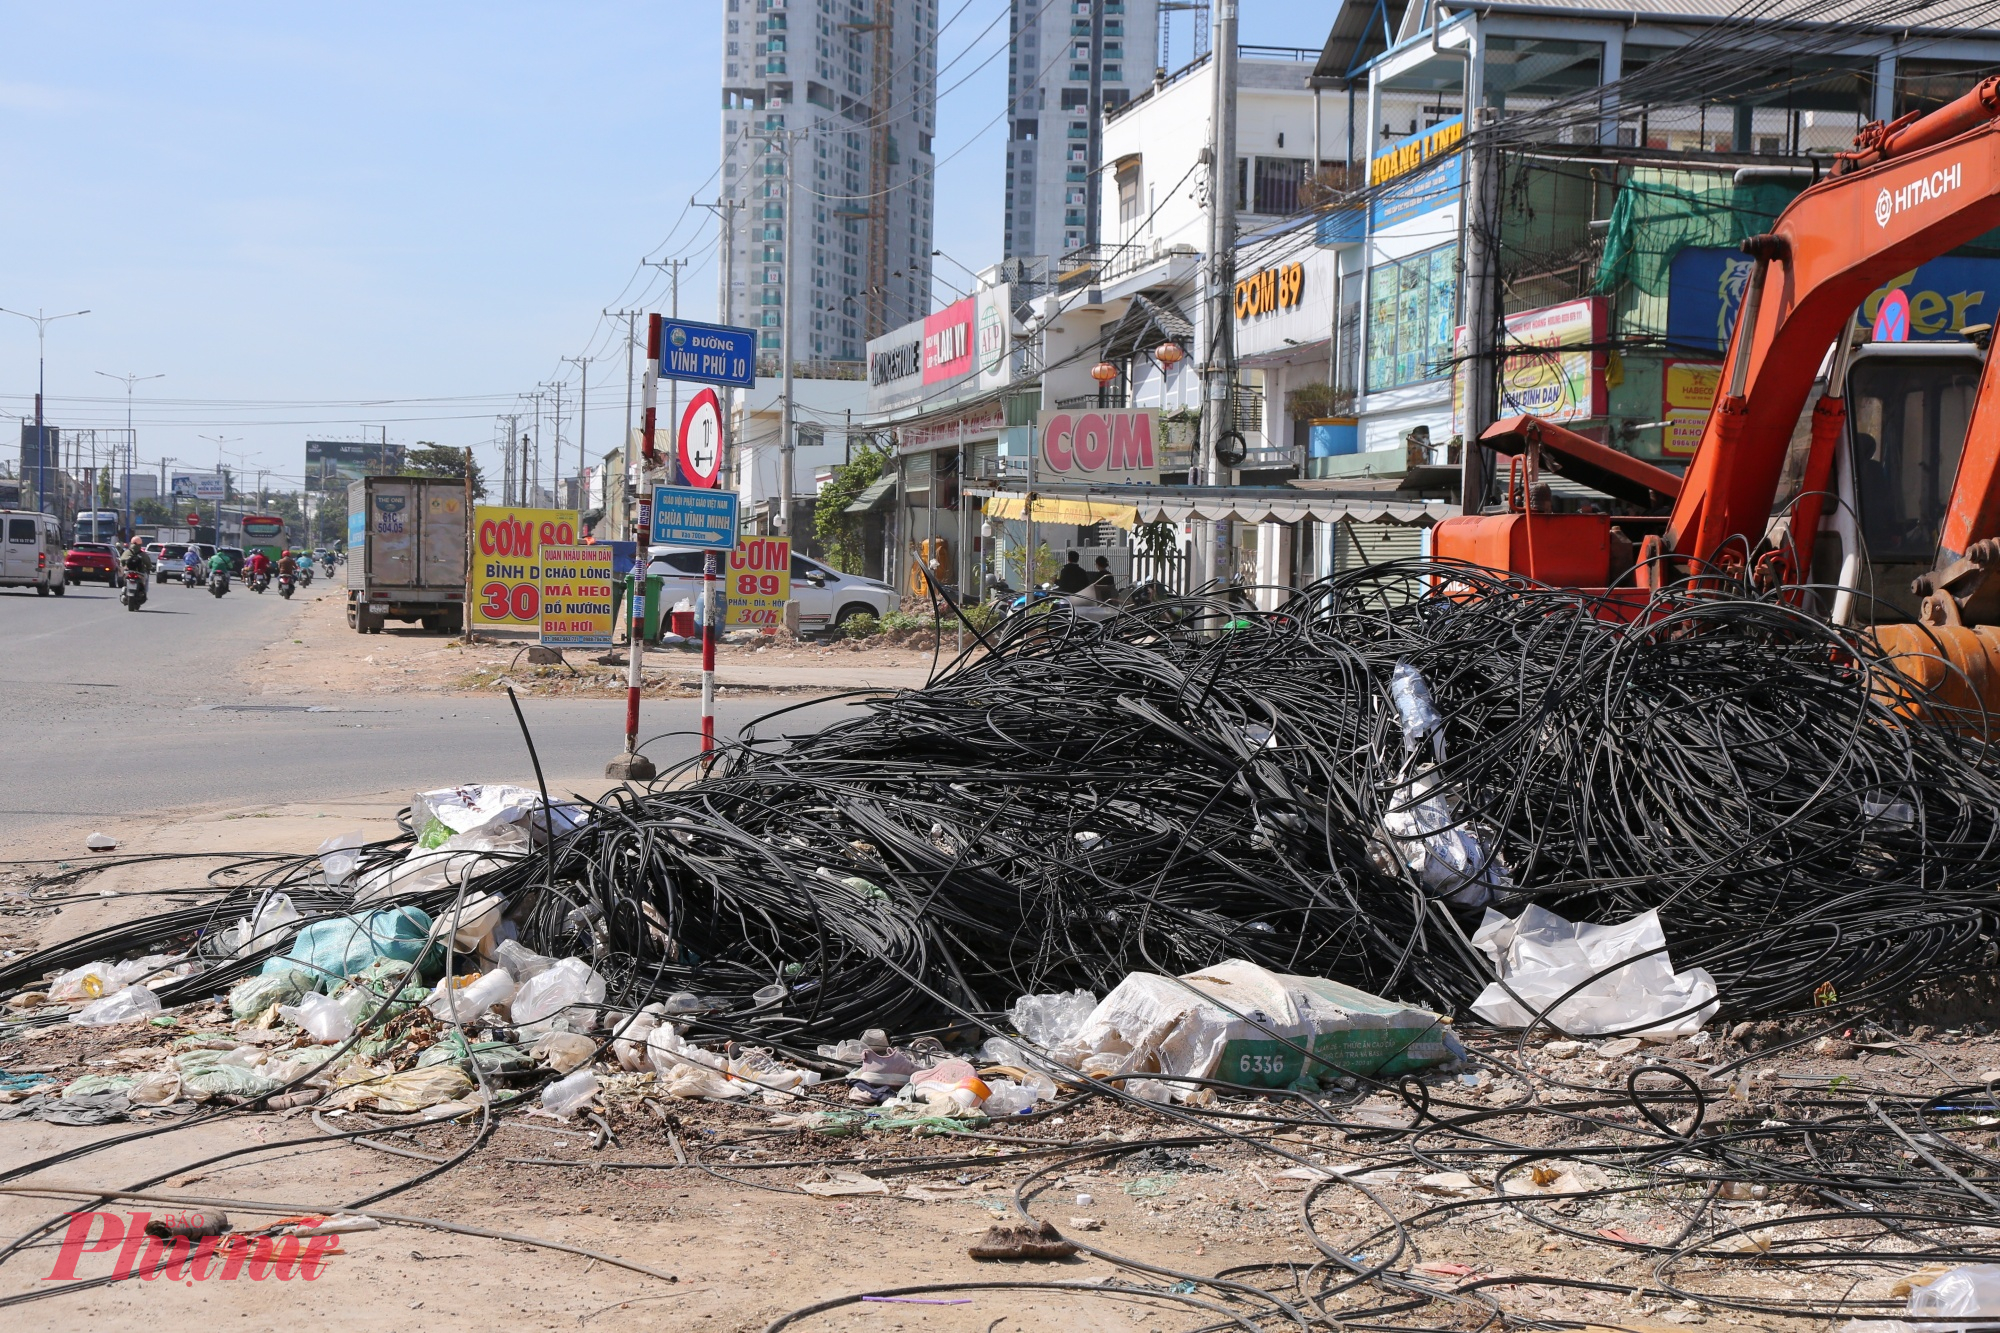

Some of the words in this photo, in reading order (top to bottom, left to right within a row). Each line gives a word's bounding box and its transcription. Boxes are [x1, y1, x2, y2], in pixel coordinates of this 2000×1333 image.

[1371, 139, 1421, 187] HOÀNG
[1895, 162, 1961, 214] HITACHI
[1235, 266, 1275, 320] CƠM
[1279, 261, 1301, 309] 89
[692, 336, 734, 351] ĐƯỜNG
[671, 348, 698, 373] VĨNH
[702, 353, 726, 376] PHÚ
[732, 358, 745, 378] 10
[1673, 428, 1687, 436] BIA
[1043, 412, 1154, 473] CƠM
[717, 500, 728, 509] NAM
[383, 513, 397, 522] 61C
[658, 509, 682, 526] CHÙA
[684, 511, 704, 528] VĨNH
[707, 514, 730, 530] MINH
[378, 523, 403, 533] 504.05
[480, 513, 533, 557] CƠM
[730, 538, 788, 571] CƠM
[486, 561, 524, 579] BÌNH
[578, 586, 610, 596] HEO
[738, 574, 779, 595] 89
[737, 608, 779, 624] 30K
[545, 621, 566, 631] BIA
[571, 620, 593, 632] HƠI
[1240, 1055, 1284, 1073] 6336
